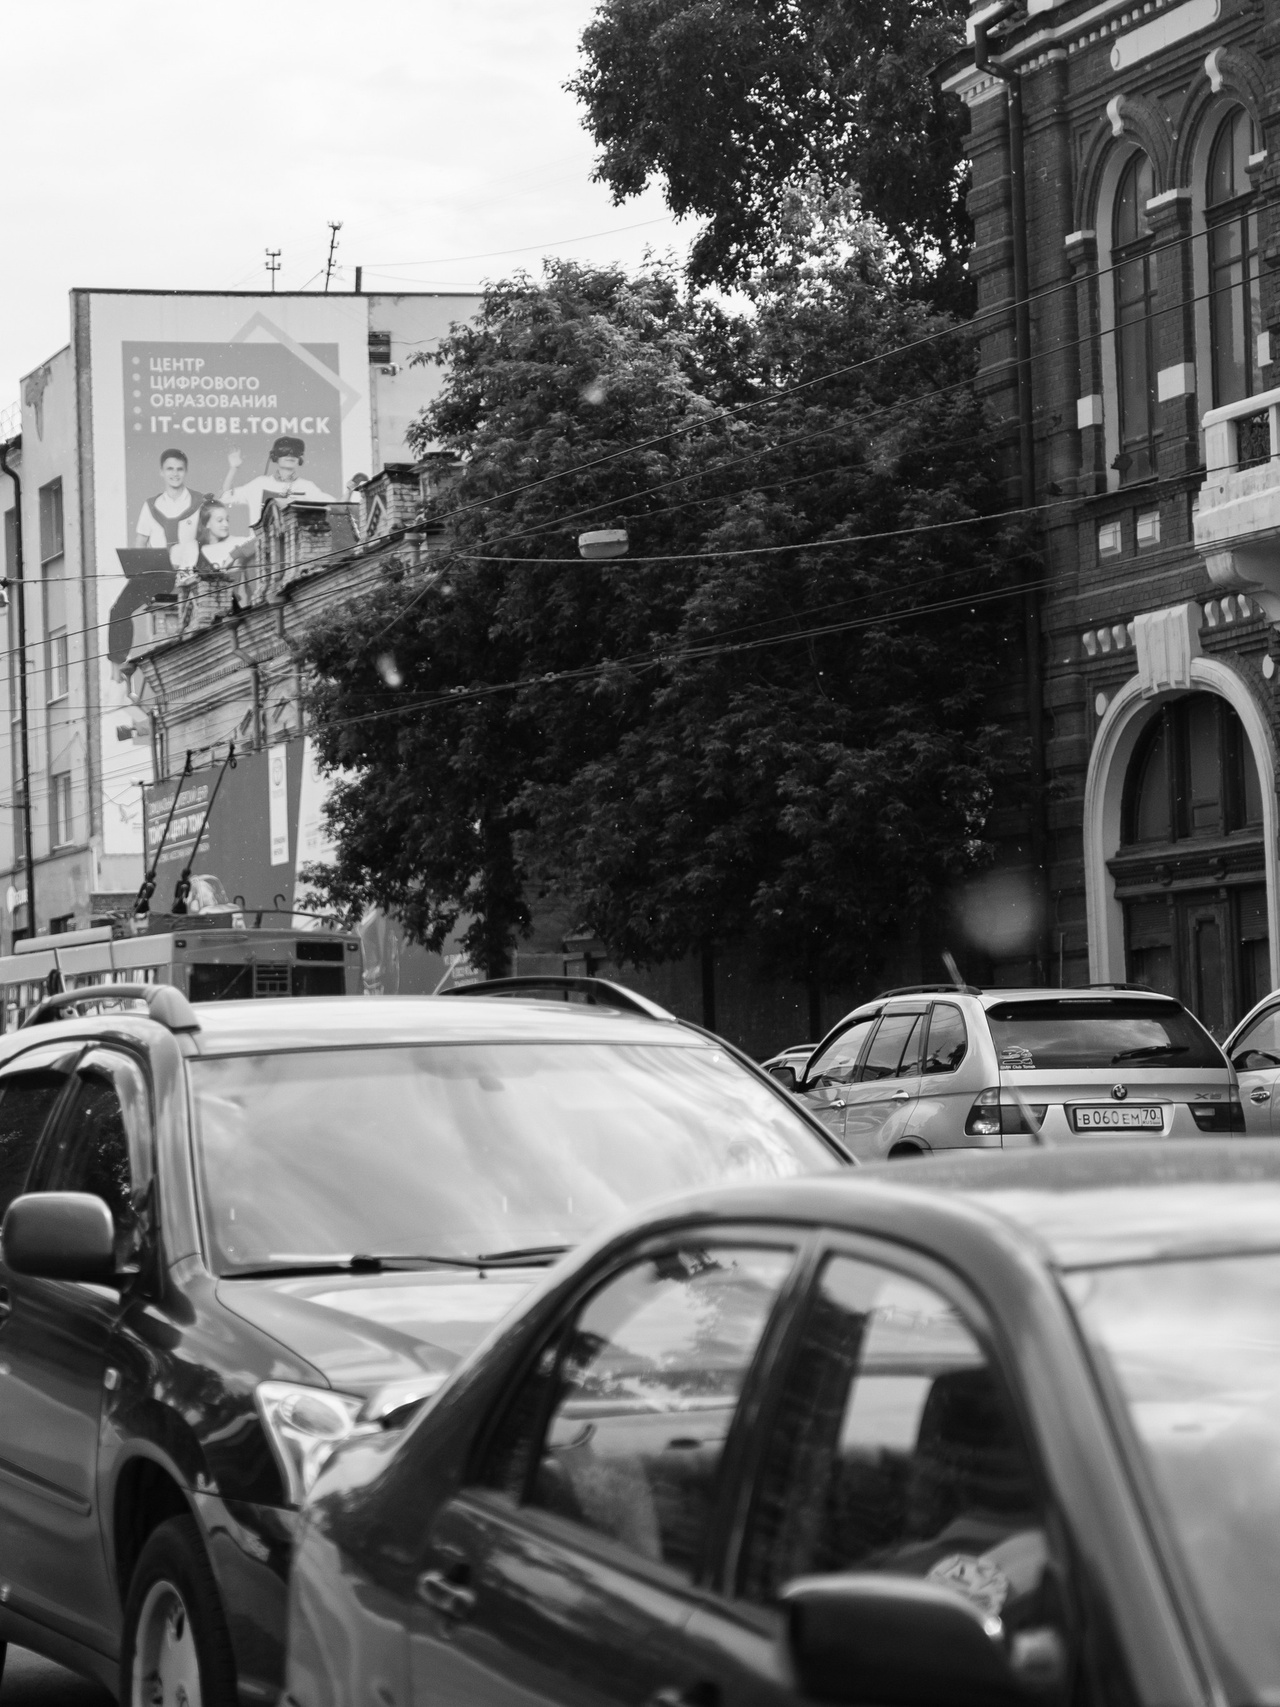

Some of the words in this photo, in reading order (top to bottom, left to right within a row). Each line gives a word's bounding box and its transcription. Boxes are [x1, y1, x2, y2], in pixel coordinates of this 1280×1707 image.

[149, 357, 205, 373] ЦЕНТР
[149, 375, 260, 390] ЦИФРОВОГО
[150, 393, 278, 408] ОБРАЗОВАНИЯ
[1142, 1109, 1157, 1120] 70
